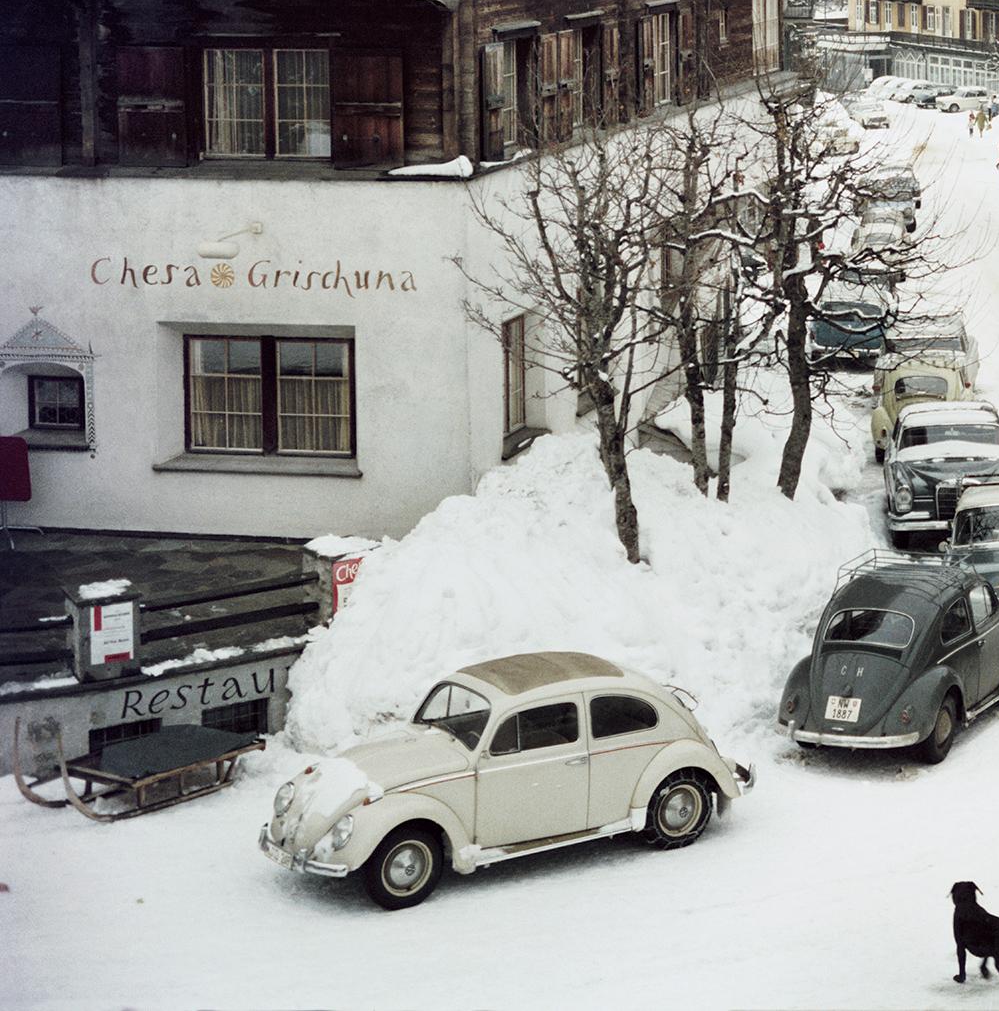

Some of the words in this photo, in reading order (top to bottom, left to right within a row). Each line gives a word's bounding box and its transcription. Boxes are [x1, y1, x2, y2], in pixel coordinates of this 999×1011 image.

[90, 257, 201, 288] Chesa
[247, 259, 417, 298] Grischuna
[336, 562, 360, 582] Che
[120, 666, 290, 720] Restau
